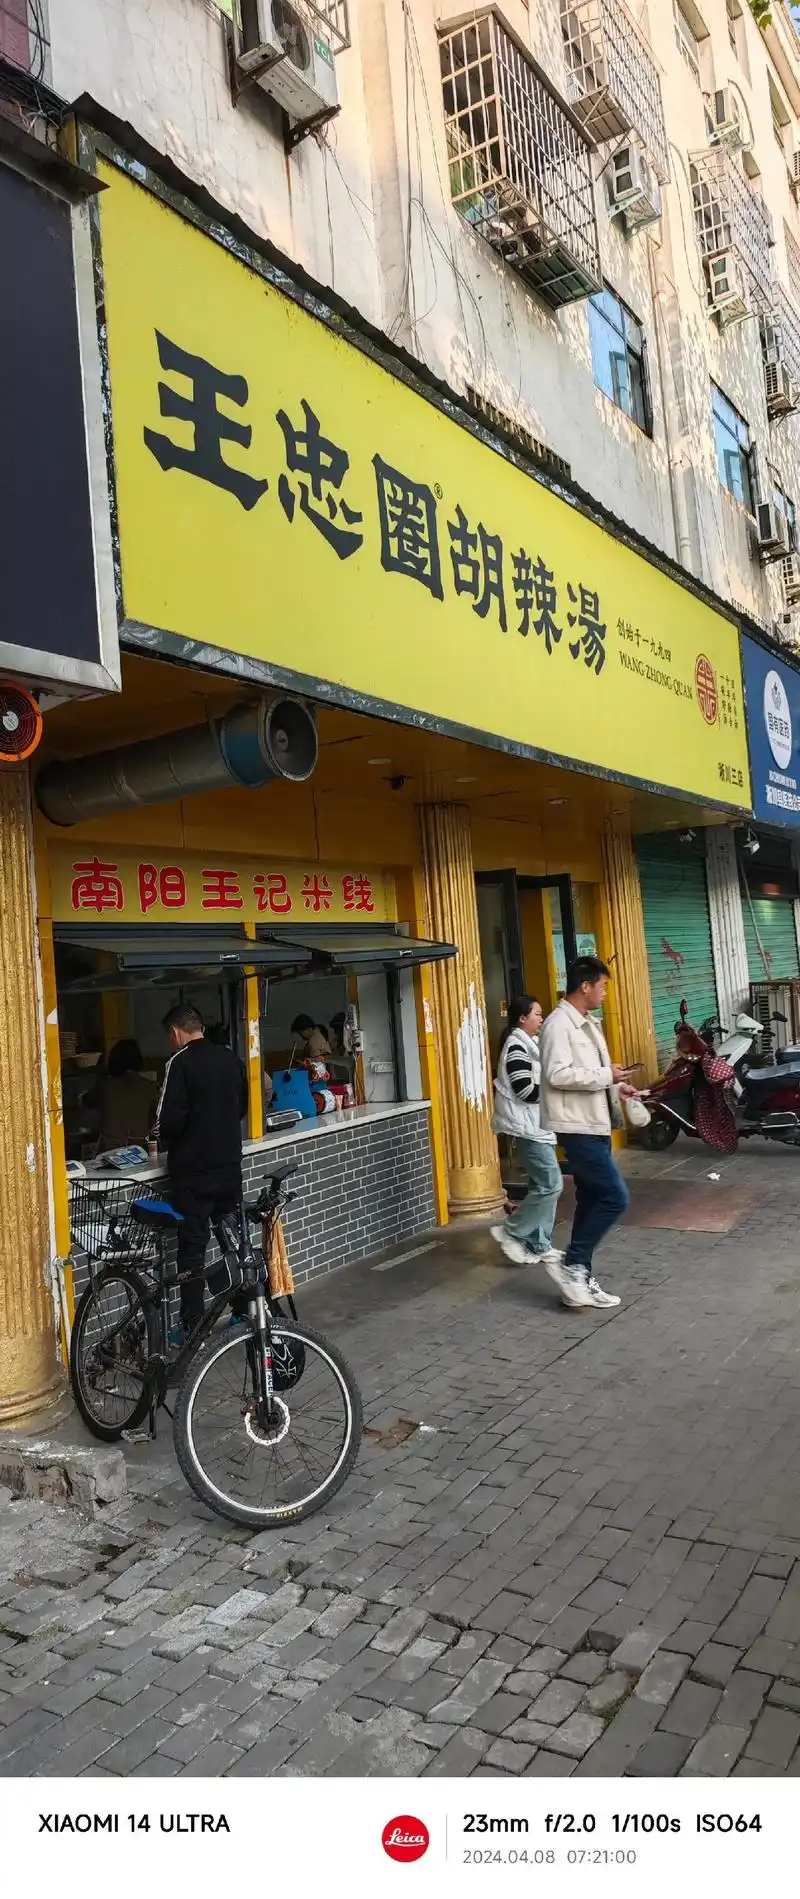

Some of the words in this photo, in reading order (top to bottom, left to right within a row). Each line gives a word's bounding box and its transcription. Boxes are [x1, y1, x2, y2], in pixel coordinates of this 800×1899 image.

[616, 617, 672, 662] 创始于一九九四
[71, 856, 376, 914] 南阳王记米线
